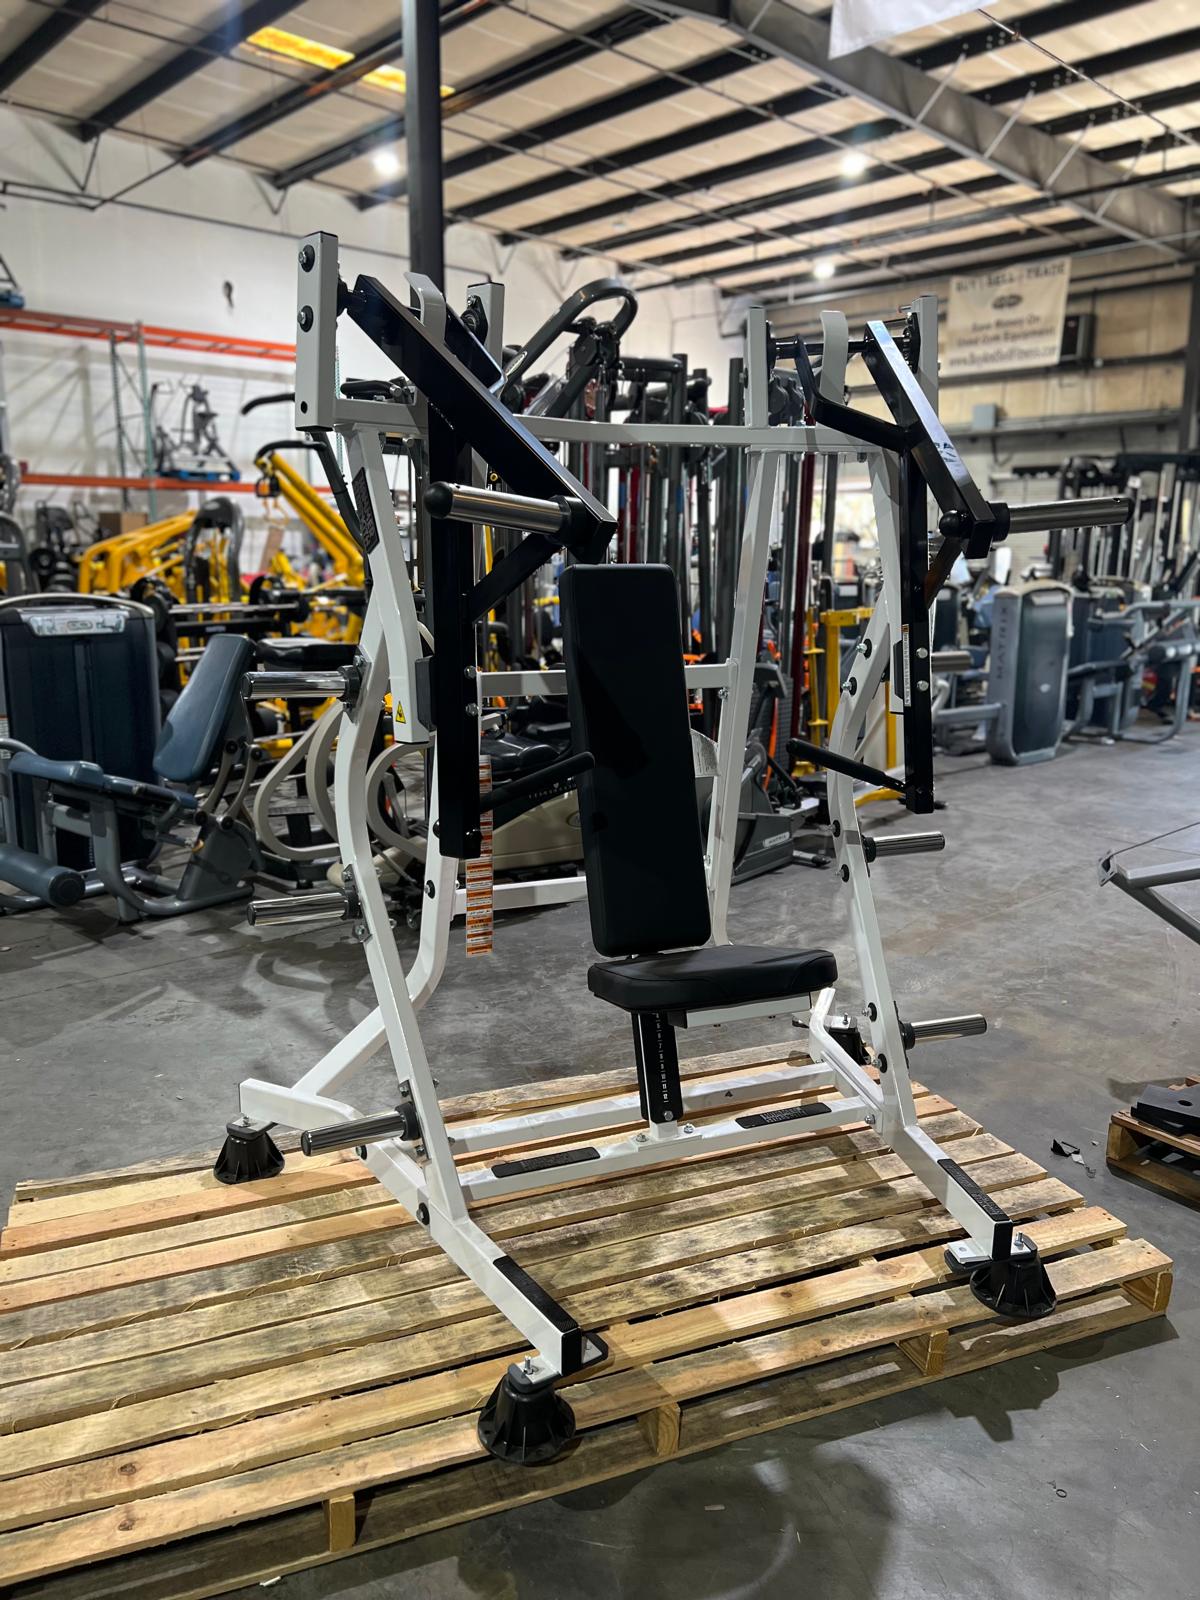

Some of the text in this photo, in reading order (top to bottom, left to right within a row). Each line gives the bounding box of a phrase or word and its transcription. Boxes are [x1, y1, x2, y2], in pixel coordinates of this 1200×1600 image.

[986, 272, 1013, 287] SELL
[1027, 263, 1065, 277] TRADE
[1003, 328, 1055, 342] Equipment
[996, 606, 1007, 679] MATRIX
